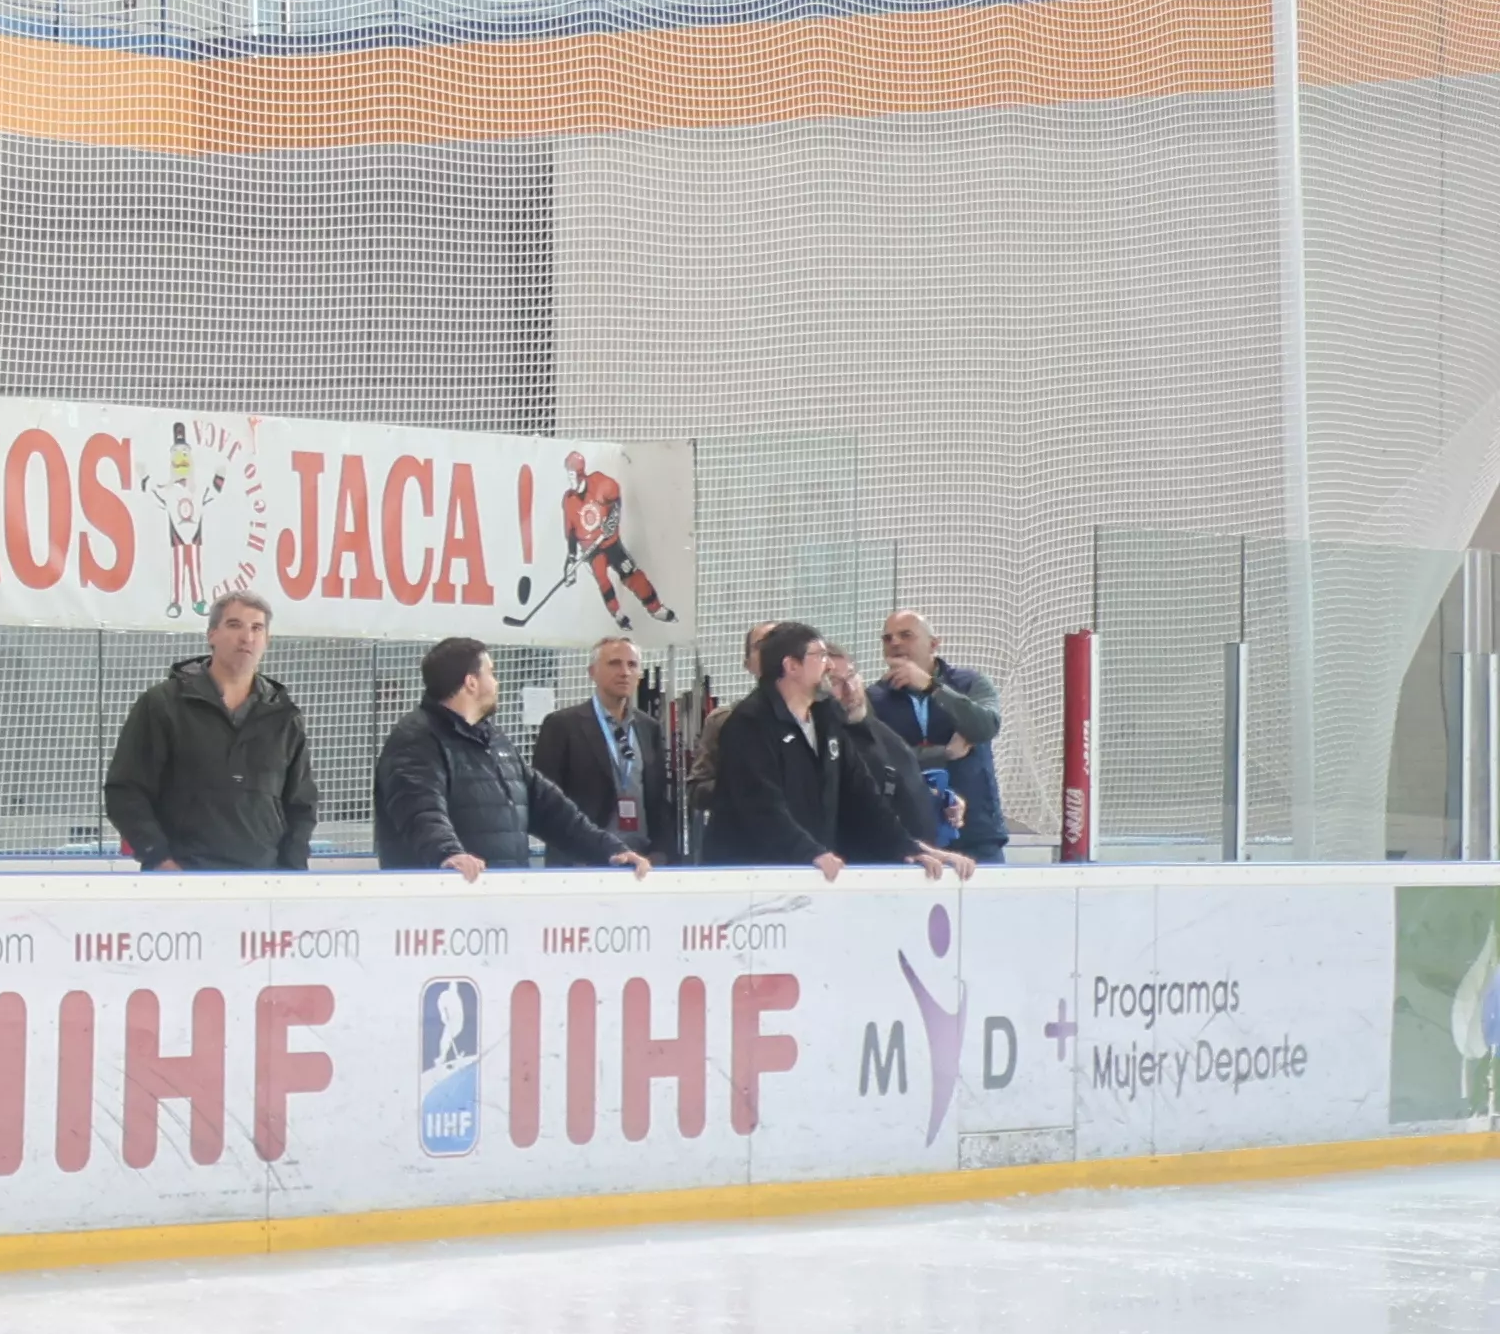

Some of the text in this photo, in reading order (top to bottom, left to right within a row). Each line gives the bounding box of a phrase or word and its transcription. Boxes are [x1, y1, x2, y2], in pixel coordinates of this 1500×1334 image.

[276, 449, 495, 606] JACA
[74, 930, 203, 963] IIHF.com
[239, 927, 361, 960] IIHF.com
[394, 925, 510, 957] IIHF.com
[542, 922, 651, 954] IIHF.com
[681, 920, 787, 952] IIHF.com
[1093, 976, 1240, 1028] Programas
[509, 972, 800, 1149] IIHF
[1092, 1037, 1308, 1101] Mujer y Deporte
[426, 1111, 473, 1139] IIHF
